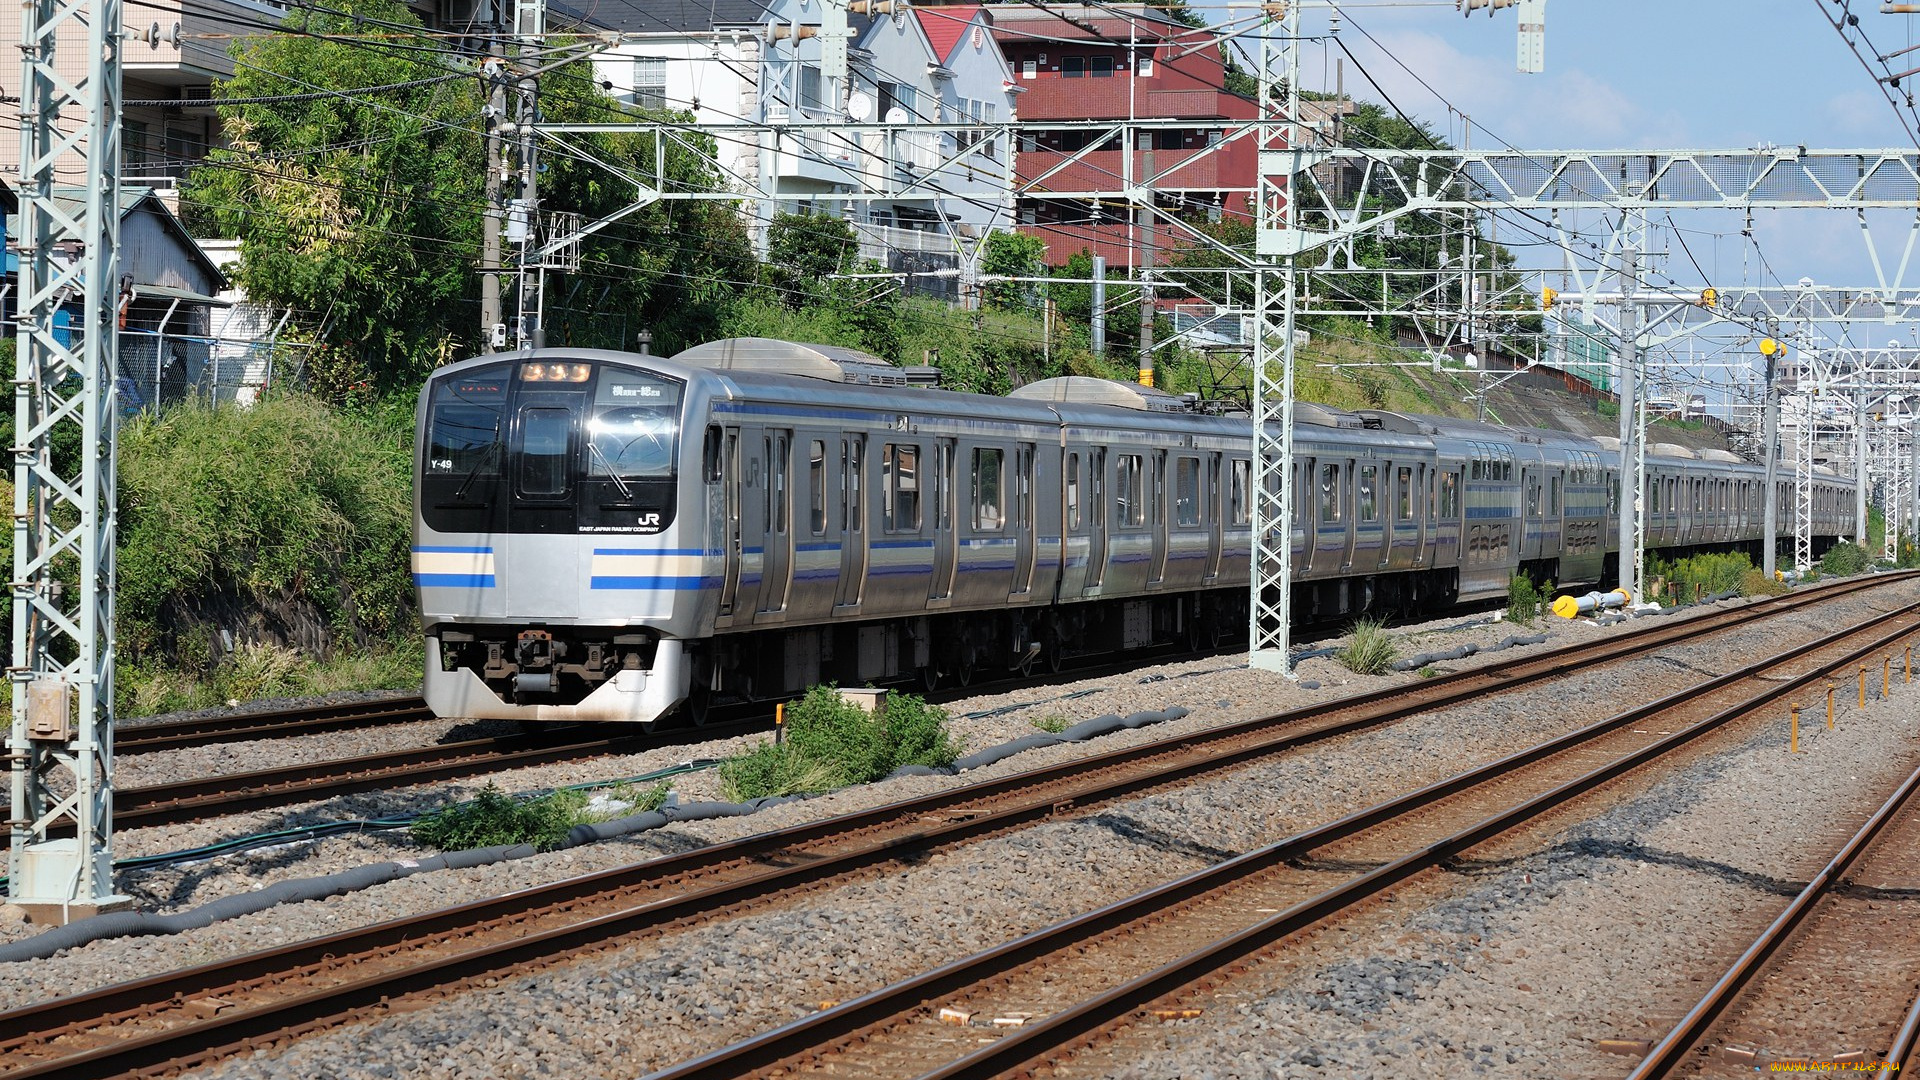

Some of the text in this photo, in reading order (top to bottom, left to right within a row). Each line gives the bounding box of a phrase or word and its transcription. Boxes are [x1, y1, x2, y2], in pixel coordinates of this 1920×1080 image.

[431, 459, 453, 469] Y-49
[746, 457, 760, 488] JR
[638, 513, 660, 526] JR
